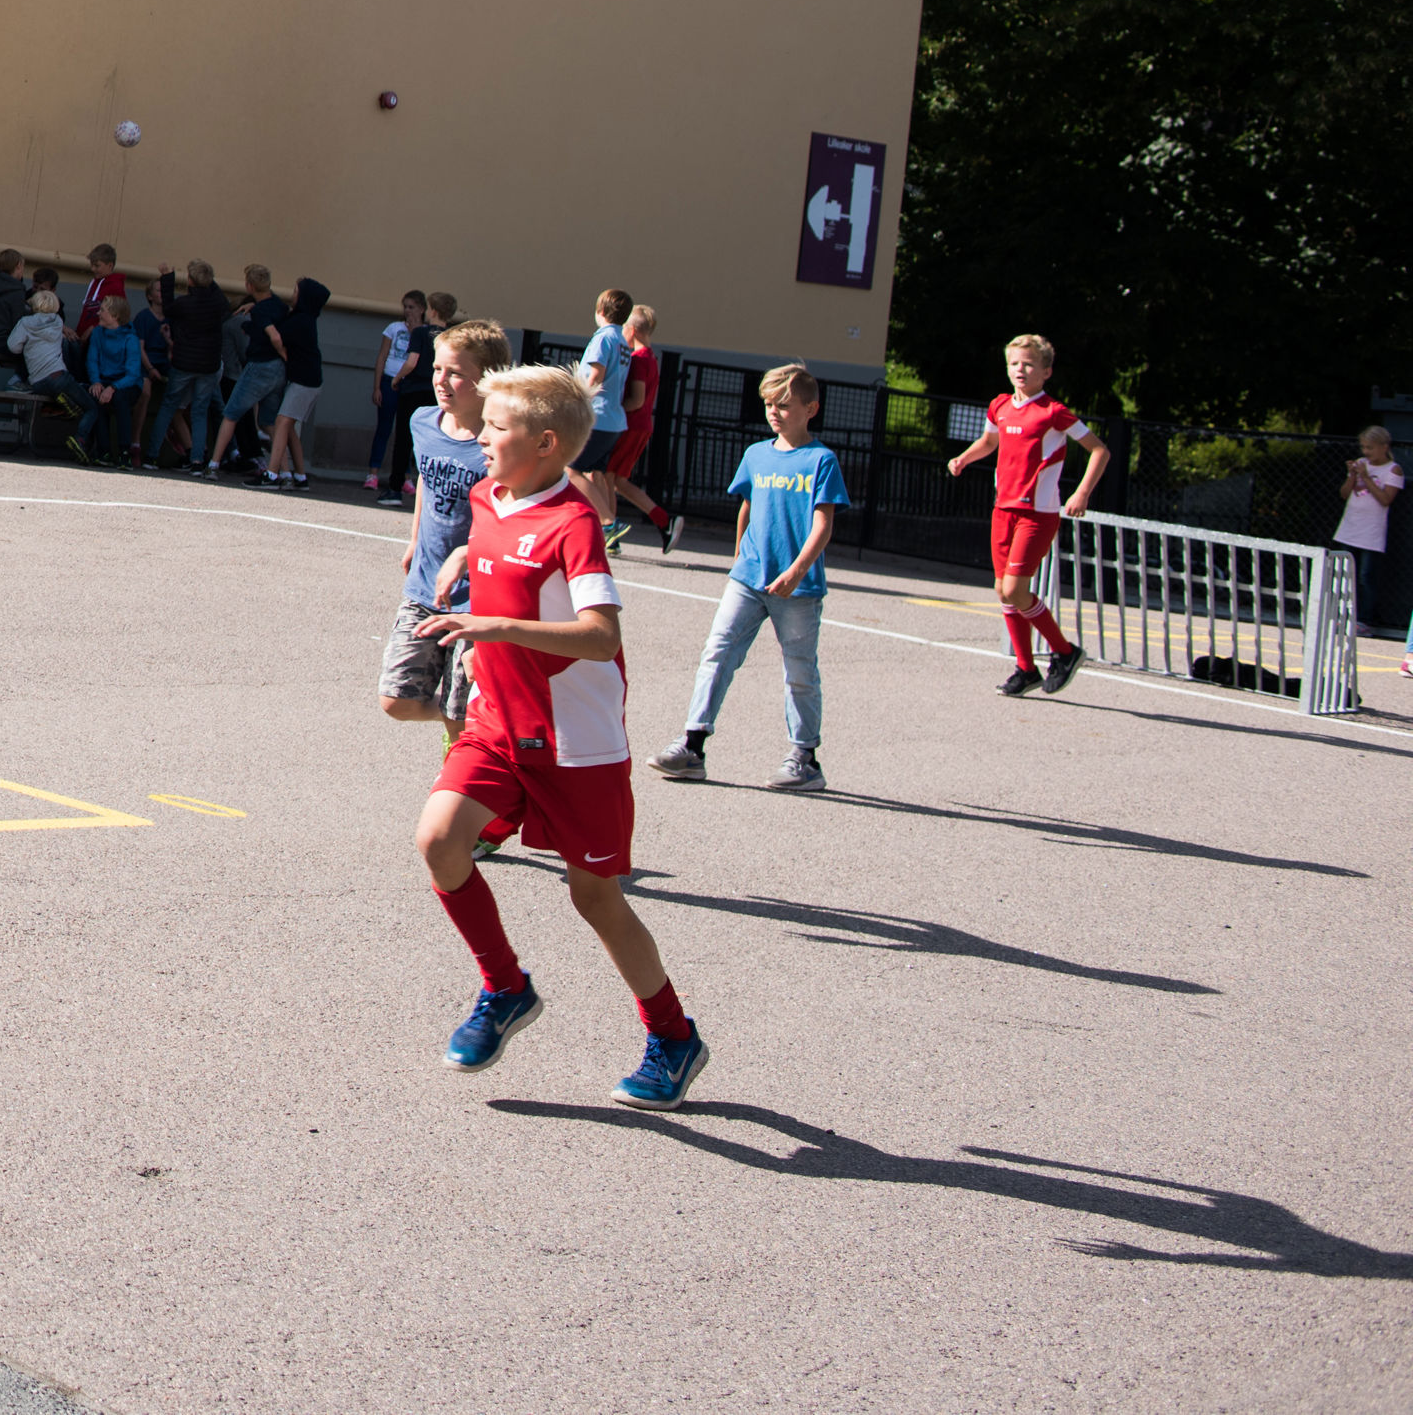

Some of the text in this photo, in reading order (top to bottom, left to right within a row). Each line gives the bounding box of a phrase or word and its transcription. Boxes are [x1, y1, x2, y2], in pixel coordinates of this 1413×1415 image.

[420, 470, 468, 501] REPUBL
[753, 472, 795, 491] Hurley
[434, 494, 456, 516] 27
[477, 557, 493, 575] KK
